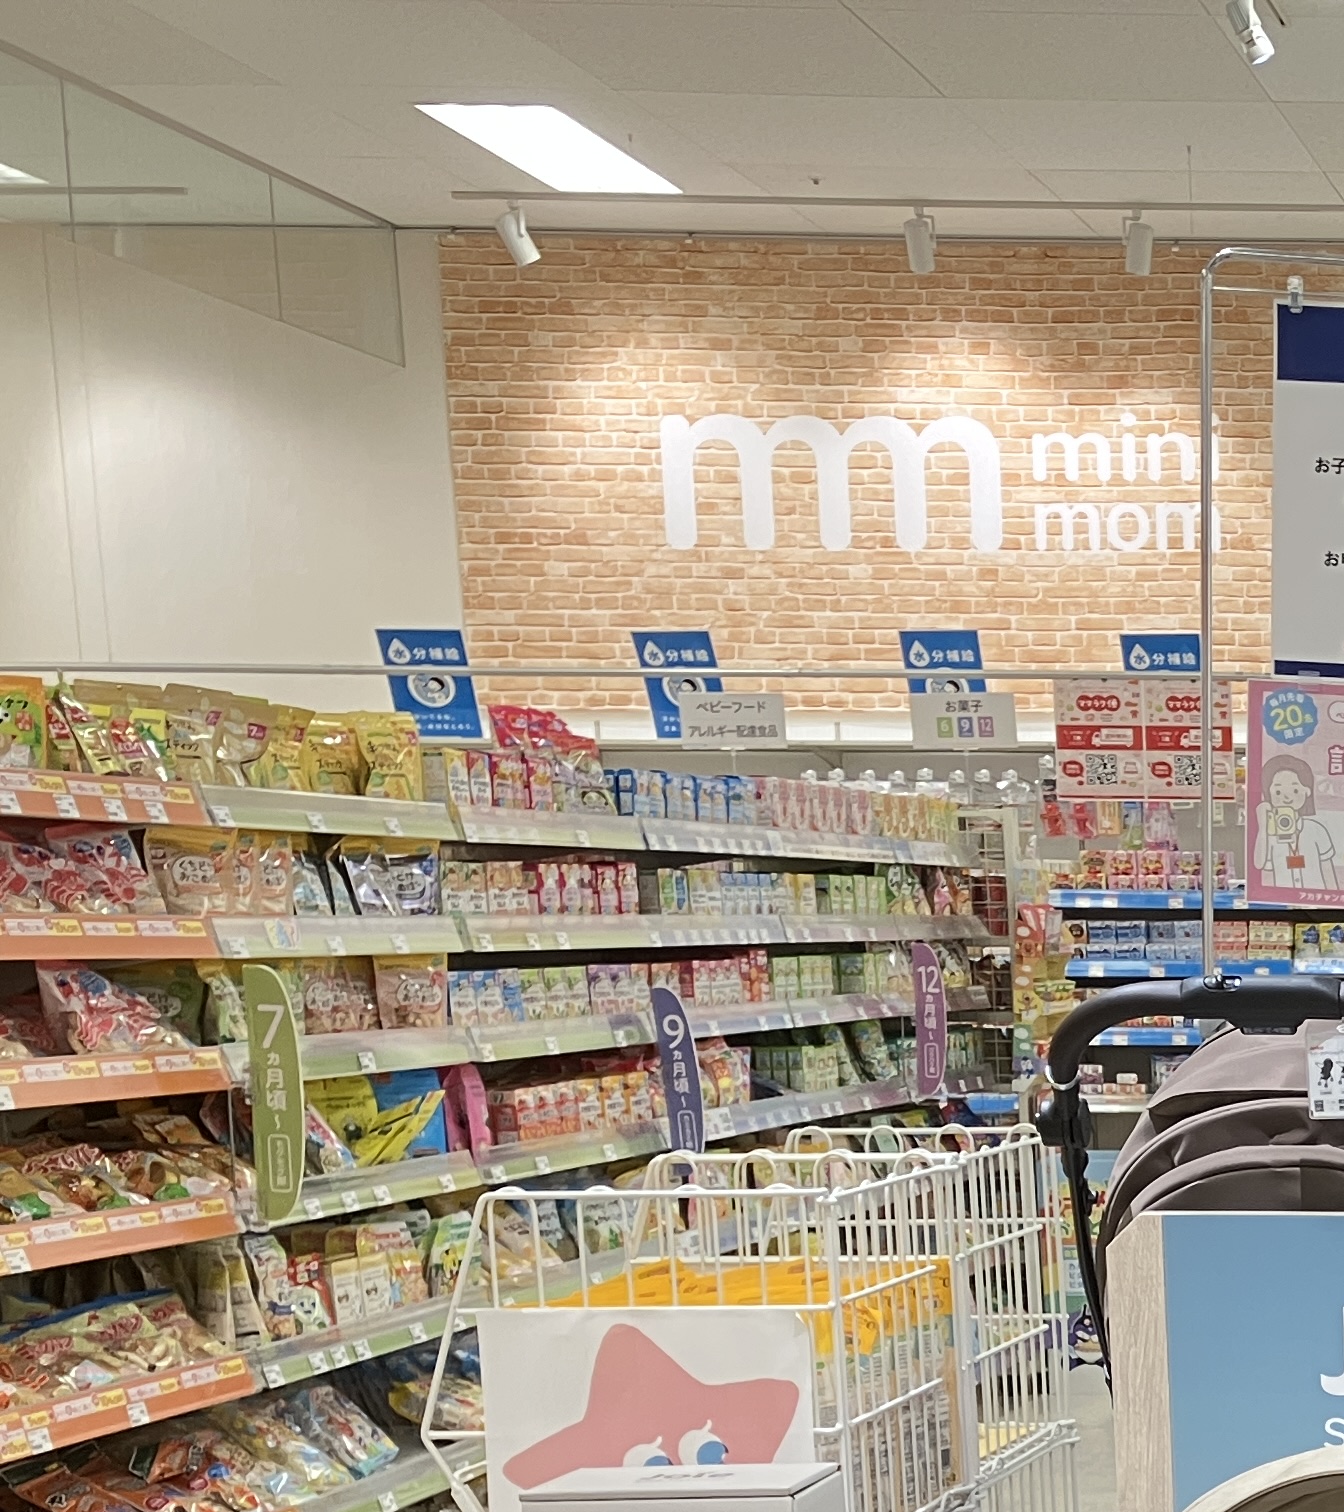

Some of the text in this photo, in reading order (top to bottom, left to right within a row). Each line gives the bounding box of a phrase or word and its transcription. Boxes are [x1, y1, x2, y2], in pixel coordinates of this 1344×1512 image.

[696, 700, 766, 713] ベビーフード
[945, 700, 983, 713] お菓子
